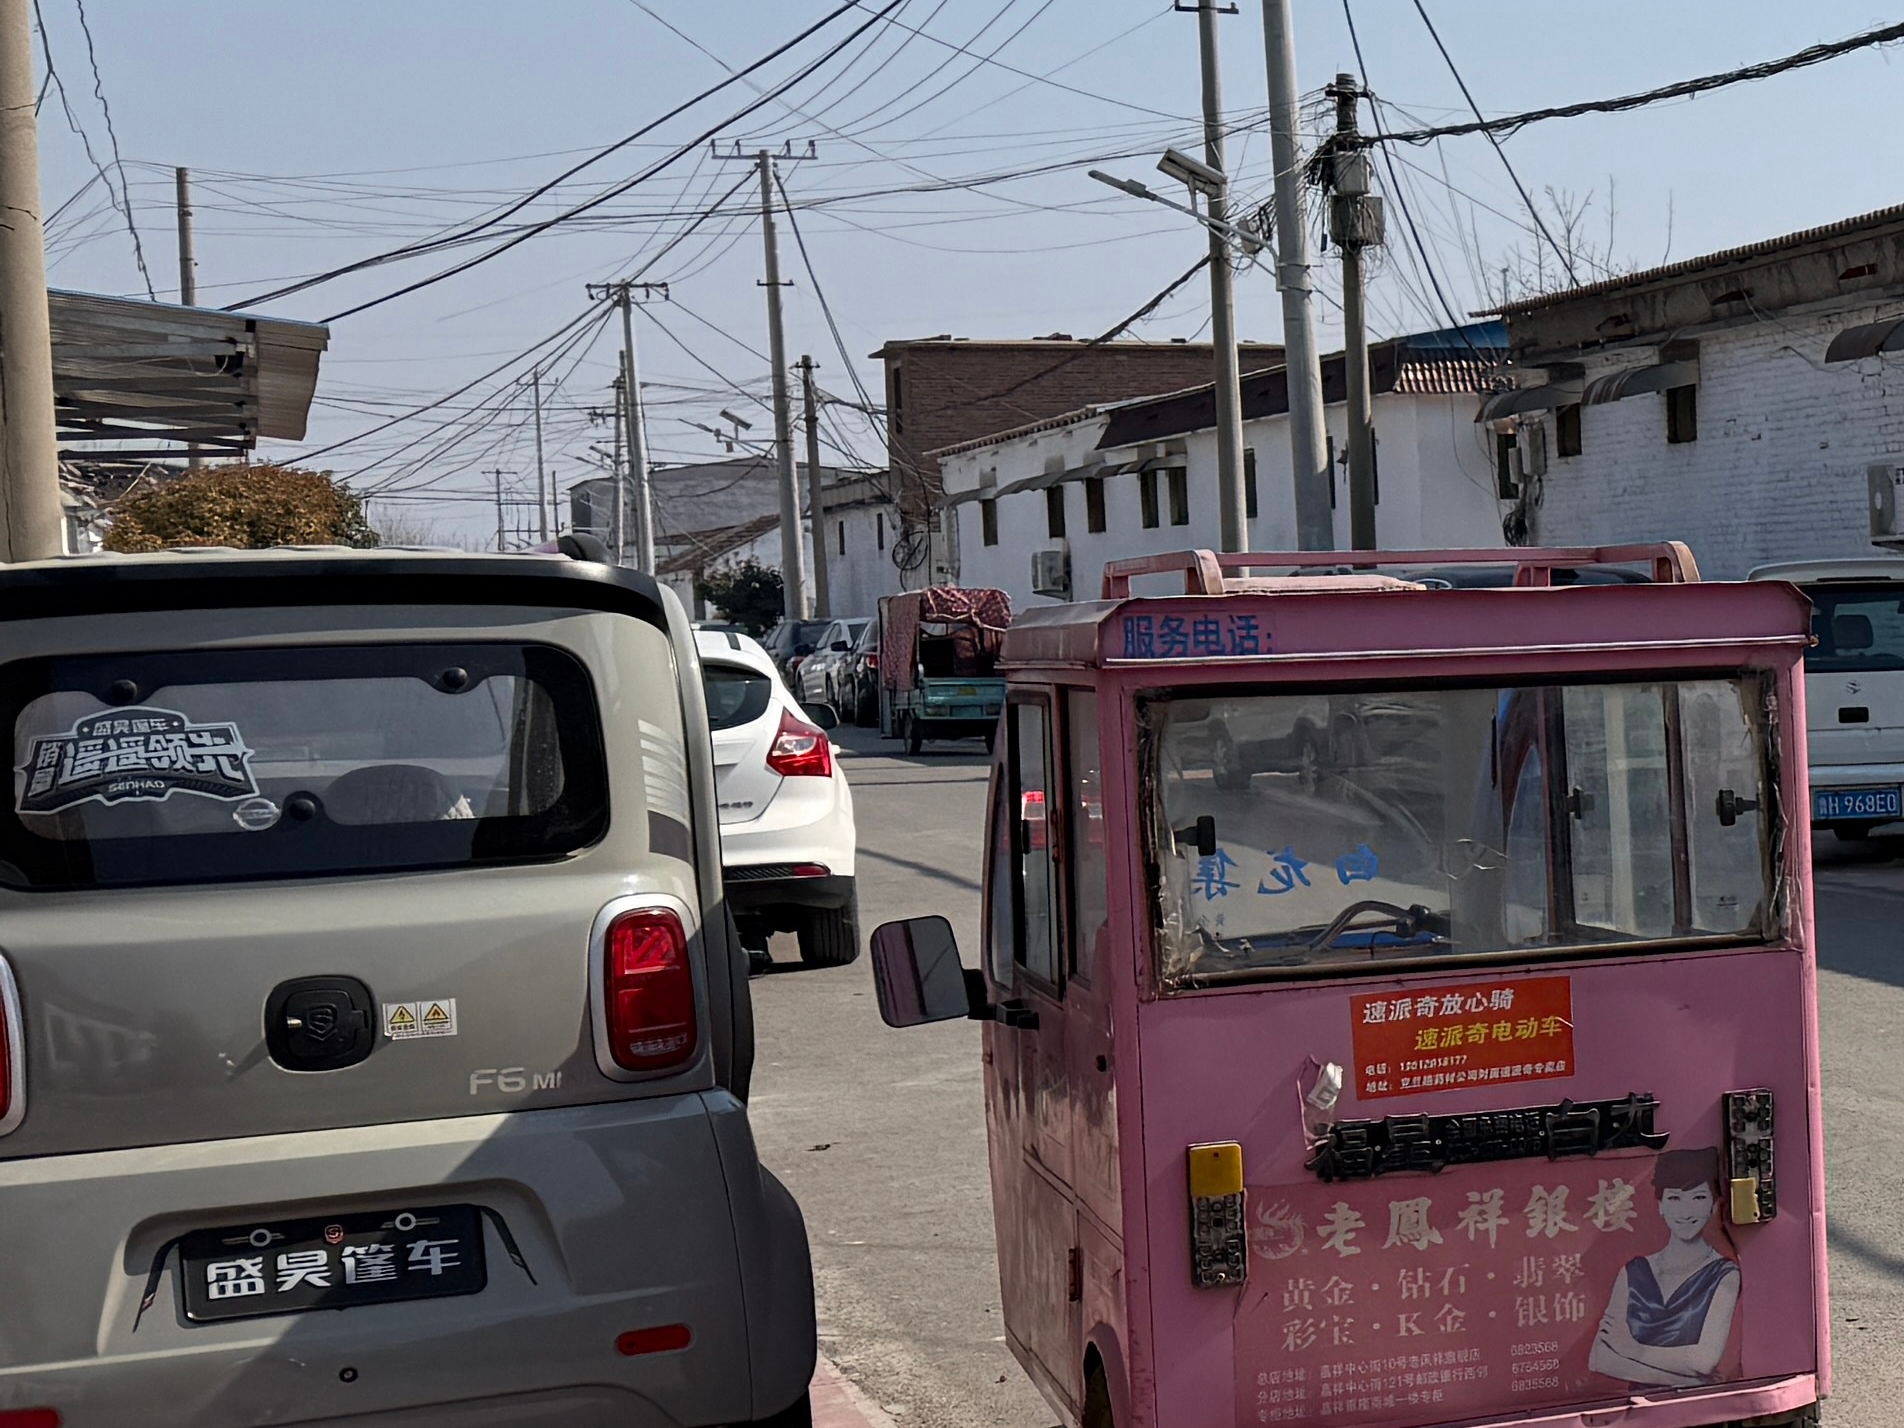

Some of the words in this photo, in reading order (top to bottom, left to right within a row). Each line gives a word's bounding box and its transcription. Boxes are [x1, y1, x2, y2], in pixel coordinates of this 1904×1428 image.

[1414, 1015, 1563, 1051] 速派奇电动车
[469, 1067, 526, 1096] F6
